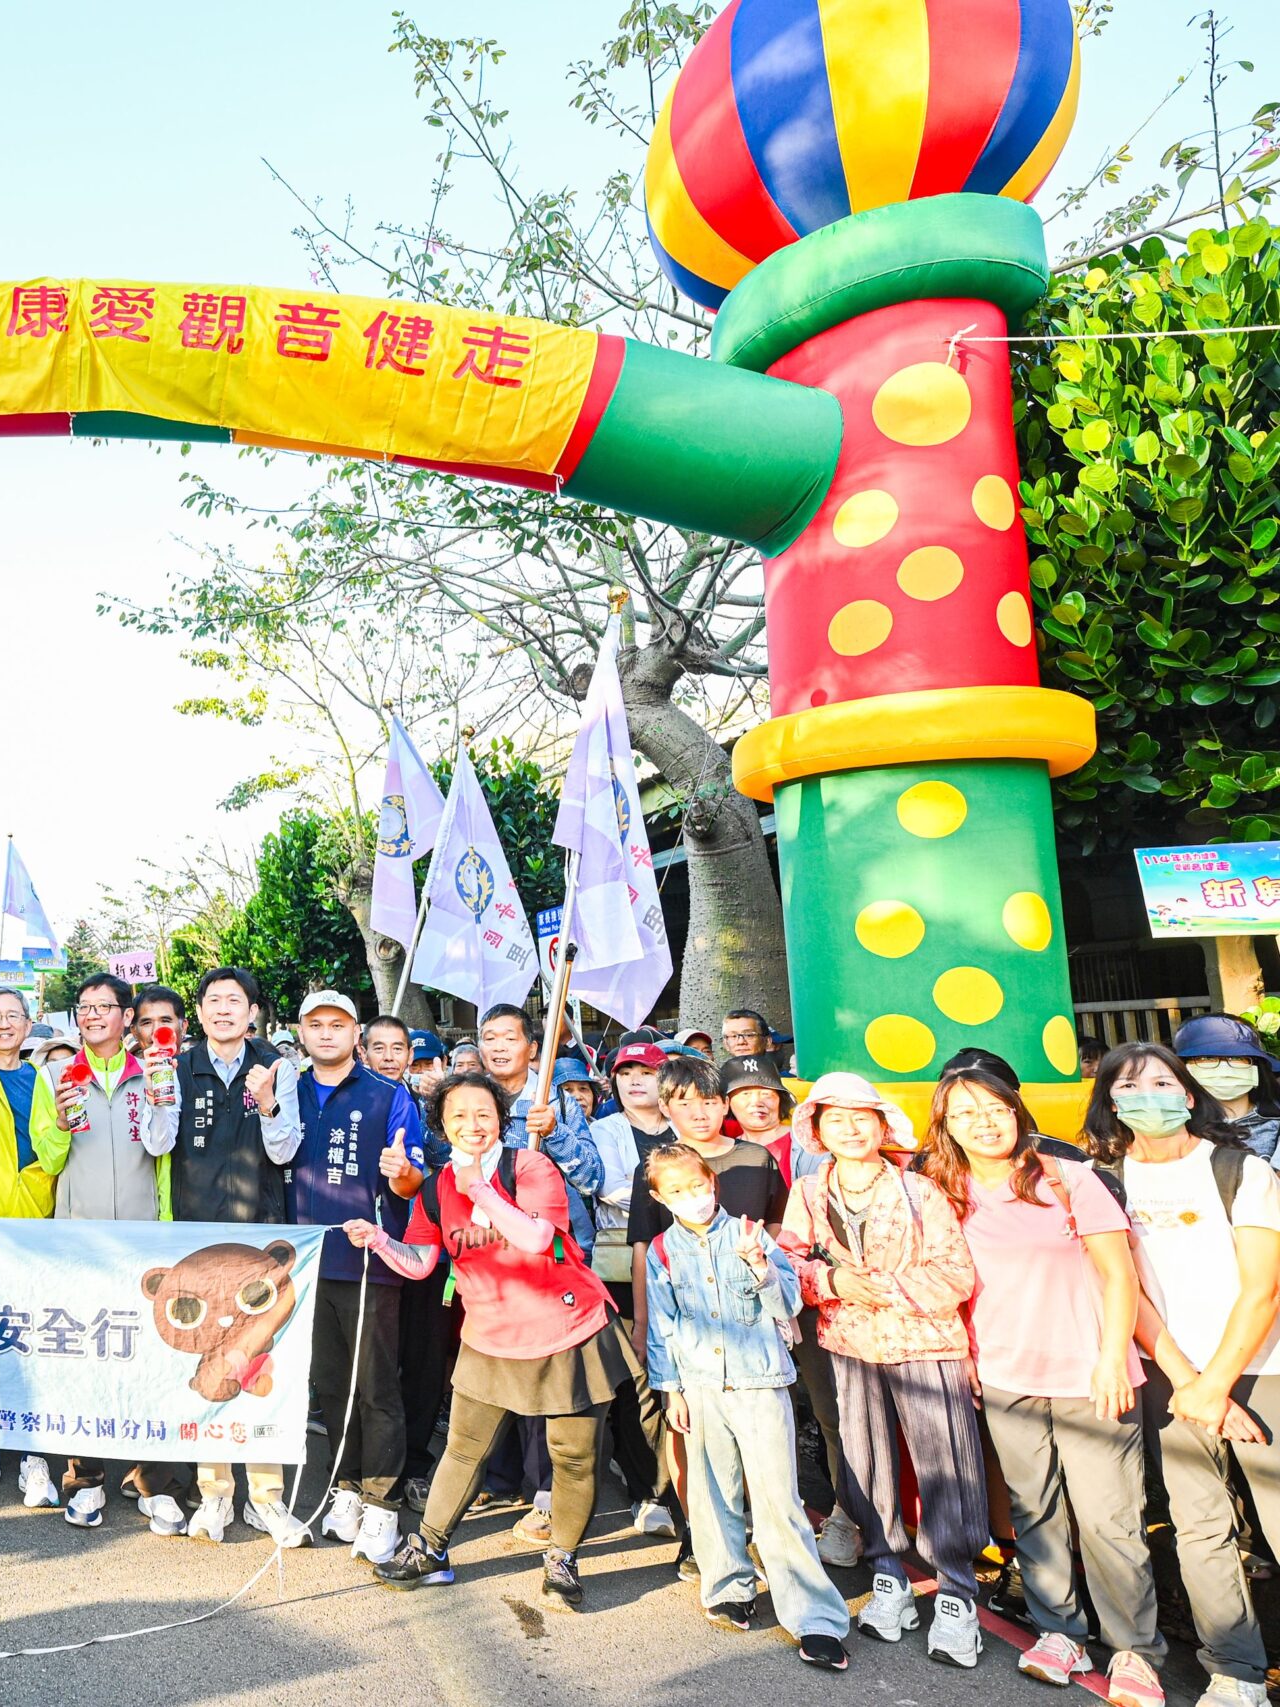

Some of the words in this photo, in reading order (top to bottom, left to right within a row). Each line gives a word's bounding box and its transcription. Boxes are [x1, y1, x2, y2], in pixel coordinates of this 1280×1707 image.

[326, 1128, 346, 1185] 涂權吉
[348, 1123, 359, 1162] 立法委員
[179, 1421, 247, 1444] 關心您
